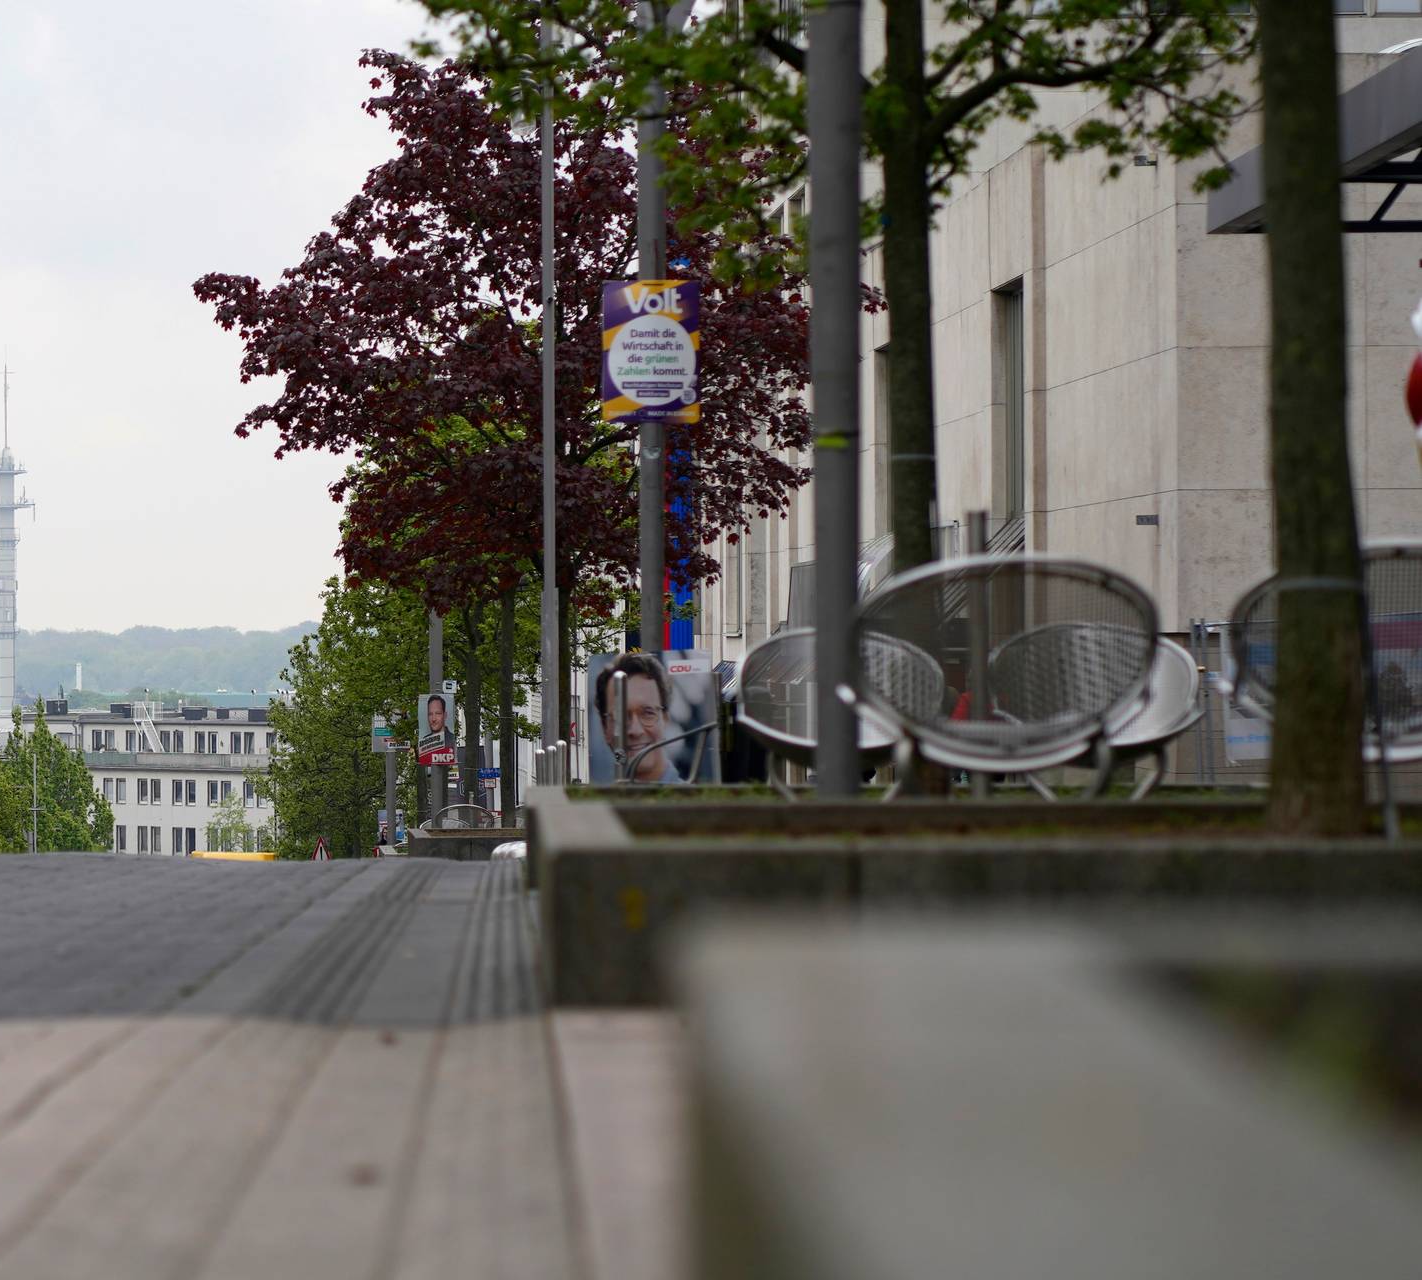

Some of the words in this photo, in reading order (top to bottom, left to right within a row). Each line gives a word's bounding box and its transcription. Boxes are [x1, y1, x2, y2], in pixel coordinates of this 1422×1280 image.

[625, 287, 683, 314] Volt
[630, 328, 660, 338] Damit
[662, 328, 676, 338] die
[622, 341, 673, 351] Wirtschaft
[676, 341, 684, 350] in
[628, 354, 643, 363] die
[645, 353, 678, 366] grünen
[617, 366, 650, 376] Zahlen
[653, 366, 688, 376] kommt.
[670, 664, 691, 673] CDU
[431, 753, 454, 762] DKP
